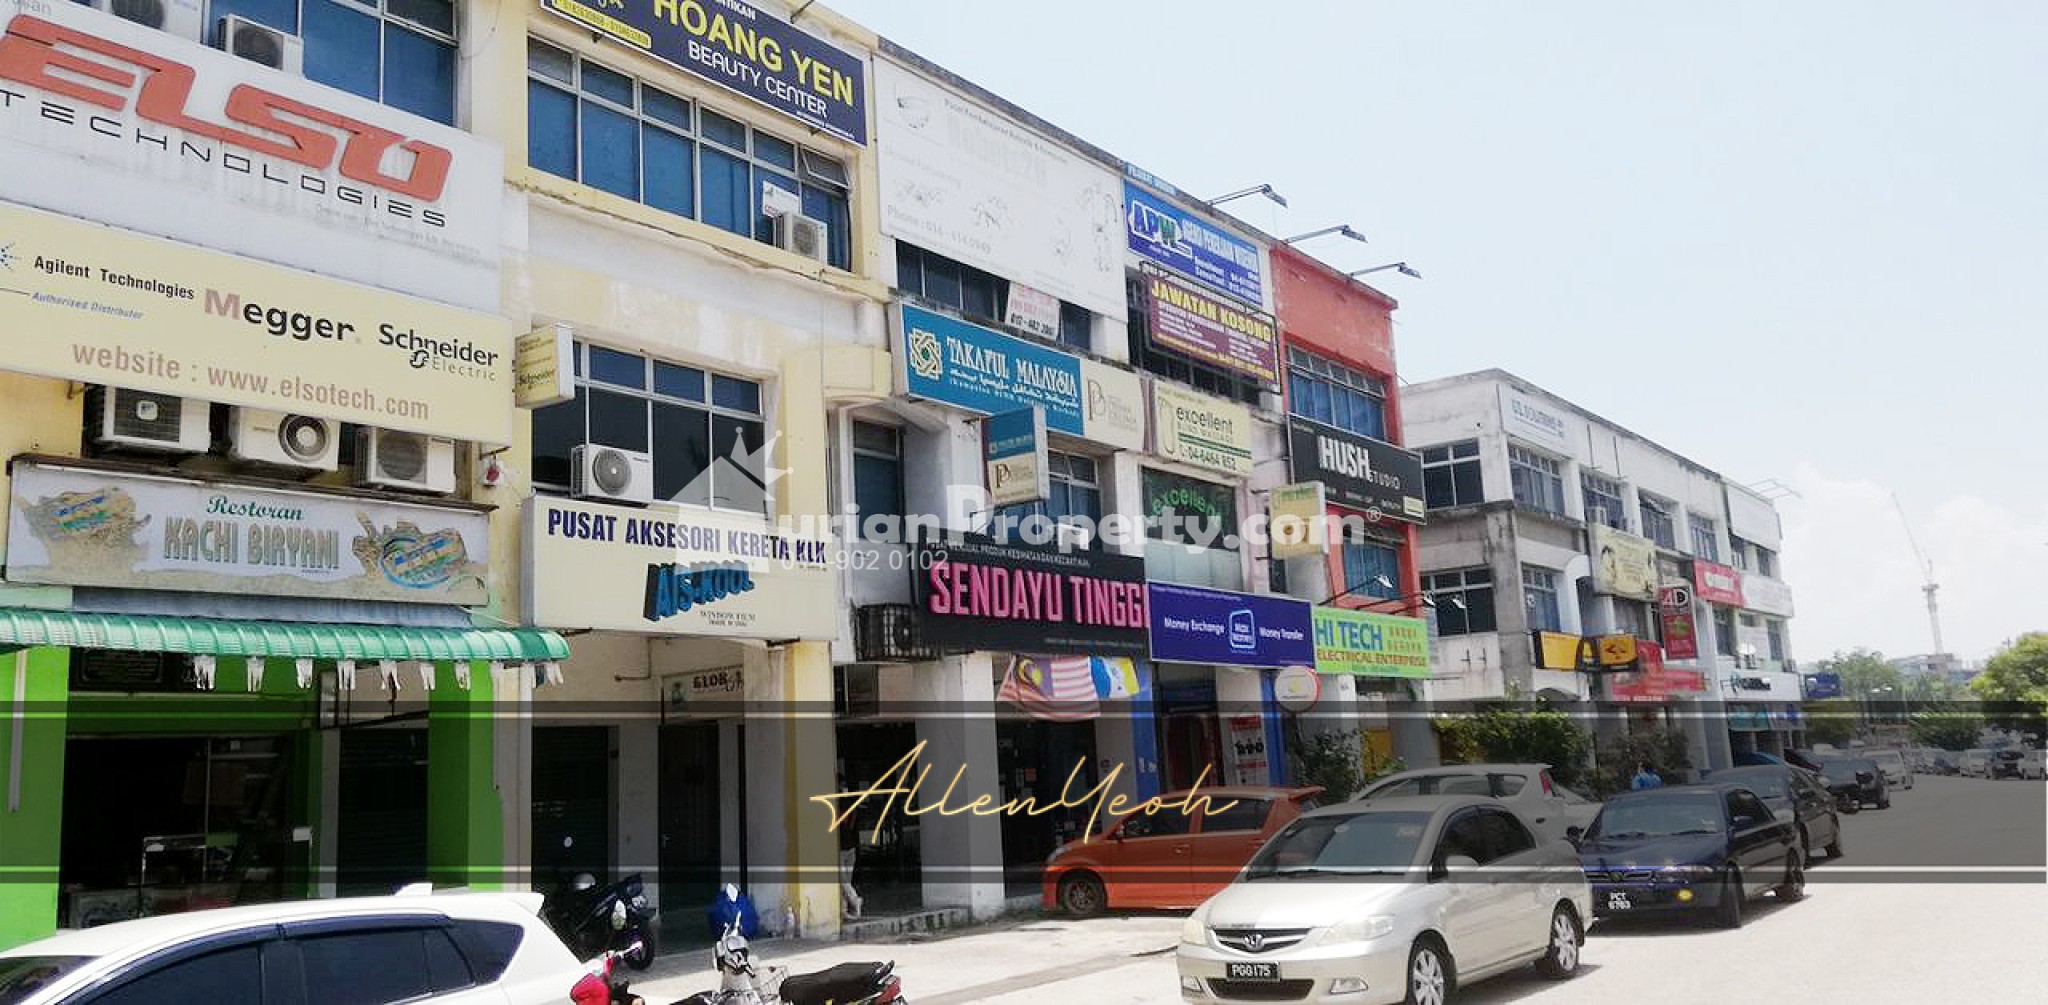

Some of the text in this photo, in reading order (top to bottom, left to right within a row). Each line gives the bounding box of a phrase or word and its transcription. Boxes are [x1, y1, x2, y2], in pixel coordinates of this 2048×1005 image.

[653, 0, 784, 73] HOANG
[792, 50, 854, 107] YEN
[688, 39, 828, 118] BEAUTY CENTER
[0, 89, 447, 229] TECHNOLOGIES
[34, 255, 195, 300] Agilent Technologies
[1152, 279, 1217, 321] JAWATAN
[1220, 306, 1272, 343] KOSONG
[378, 323, 499, 367] Schneider
[431, 356, 497, 382] Electric
[947, 335, 1079, 398] TAKAFUL MALAYSIA
[72, 343, 180, 379] website
[207, 365, 430, 421] www.elsotech.com
[1176, 407, 1233, 436] excellent
[1319, 436, 1371, 480] HUSH
[206, 494, 305, 522] Restoran
[163, 516, 239, 565] KACHI
[248, 521, 340, 570] BIRYANI
[548, 508, 827, 565] PUSAT AKSESORI KERETA KLK
[929, 560, 1064, 624] SENDAYU
[1164, 616, 1225, 636] Money Exchange
[1259, 625, 1281, 641] Money
[1336, 620, 1383, 652] TECH
